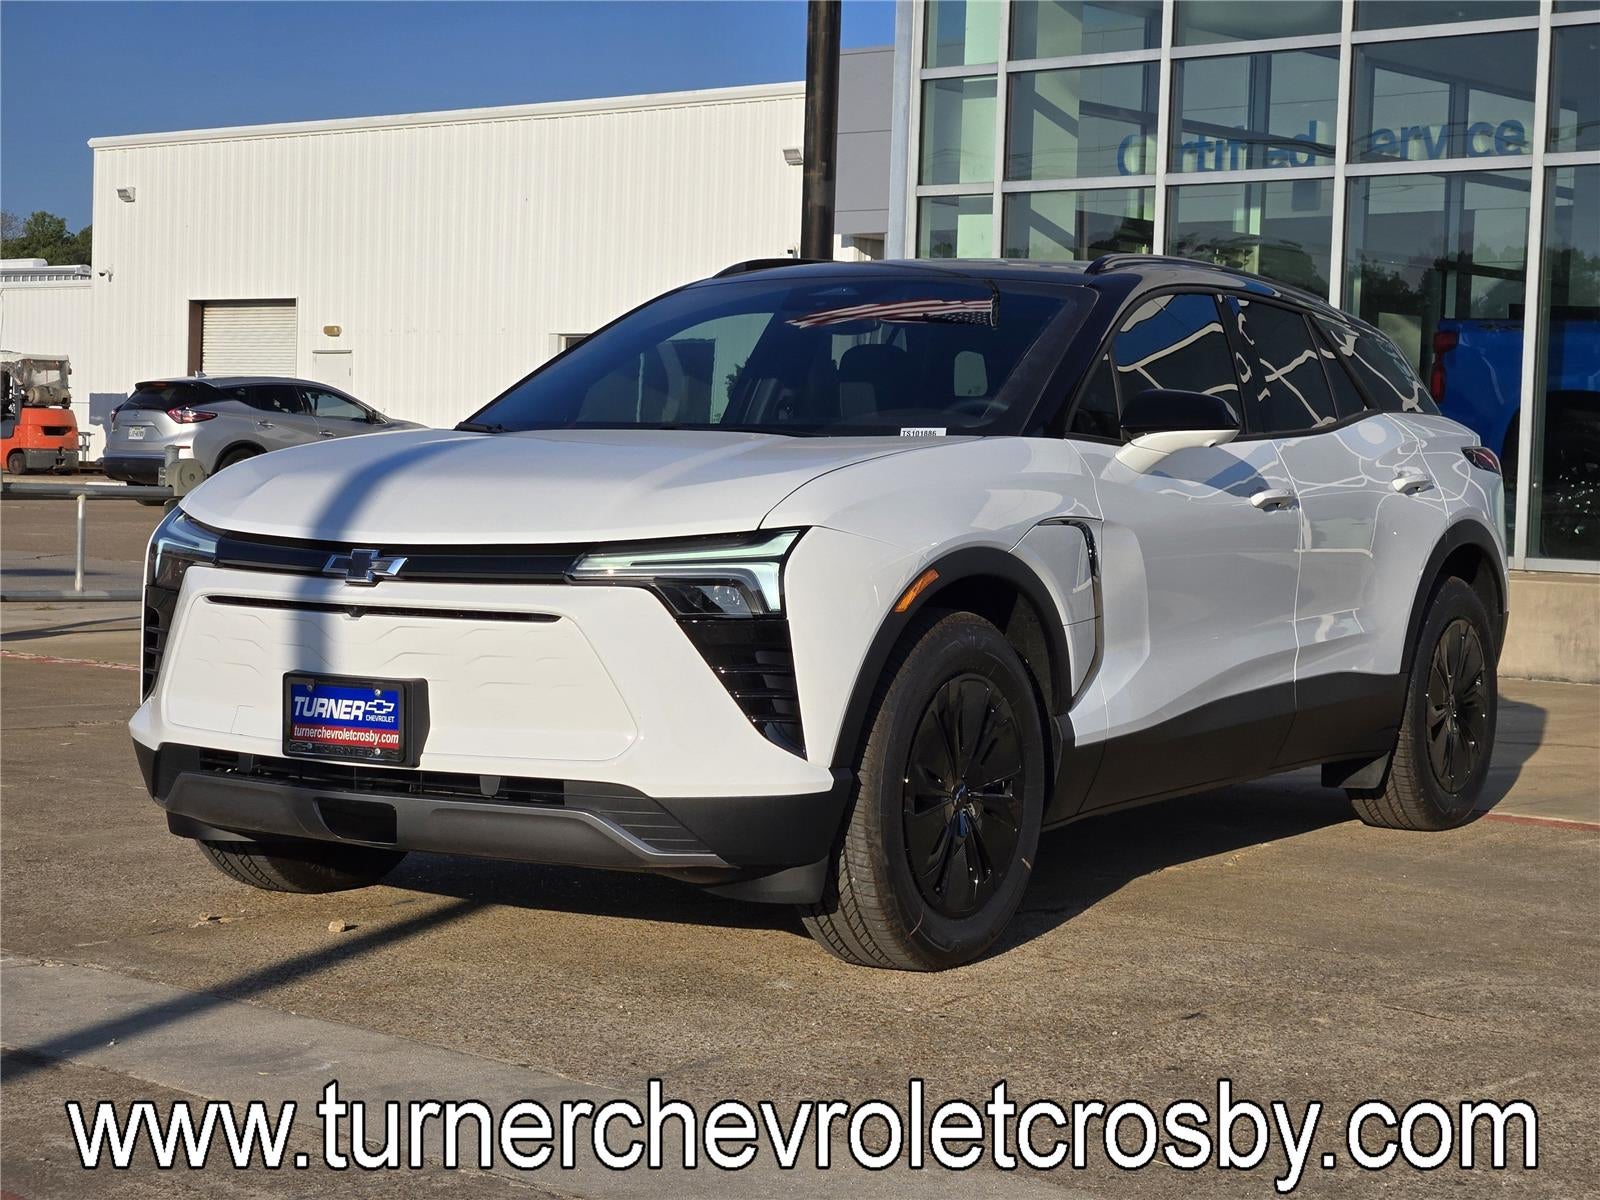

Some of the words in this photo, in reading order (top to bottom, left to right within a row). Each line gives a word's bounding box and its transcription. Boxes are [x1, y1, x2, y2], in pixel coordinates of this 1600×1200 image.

[294, 696, 366, 721] TURNER
[365, 714, 395, 723] CHEVROLET
[294, 726, 399, 745] turnerchevroletcrosby.com
